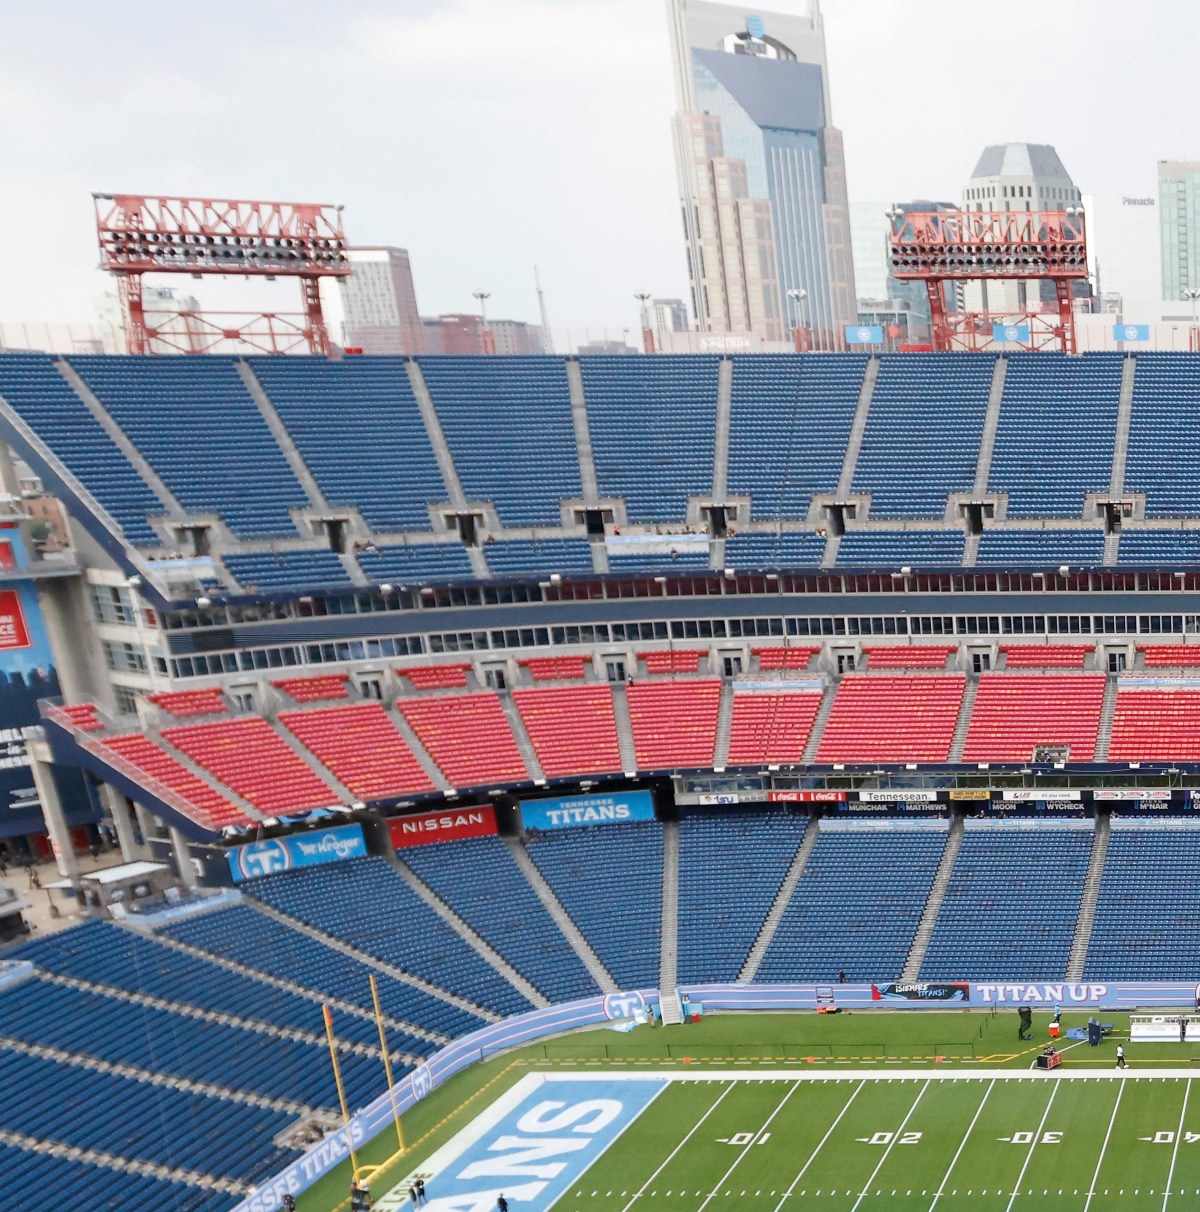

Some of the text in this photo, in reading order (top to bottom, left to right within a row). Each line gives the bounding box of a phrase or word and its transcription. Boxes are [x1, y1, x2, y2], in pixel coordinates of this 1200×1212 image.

[1122, 196, 1155, 206] Pinnacle
[560, 799, 614, 809] TENNESSEE
[546, 804, 631, 825] TITANS
[402, 813, 483, 834] NISSAN
[318, 833, 360, 857] Kroger
[917, 988, 945, 997] TITANS!
[977, 985, 1109, 1002] TITAN UP
